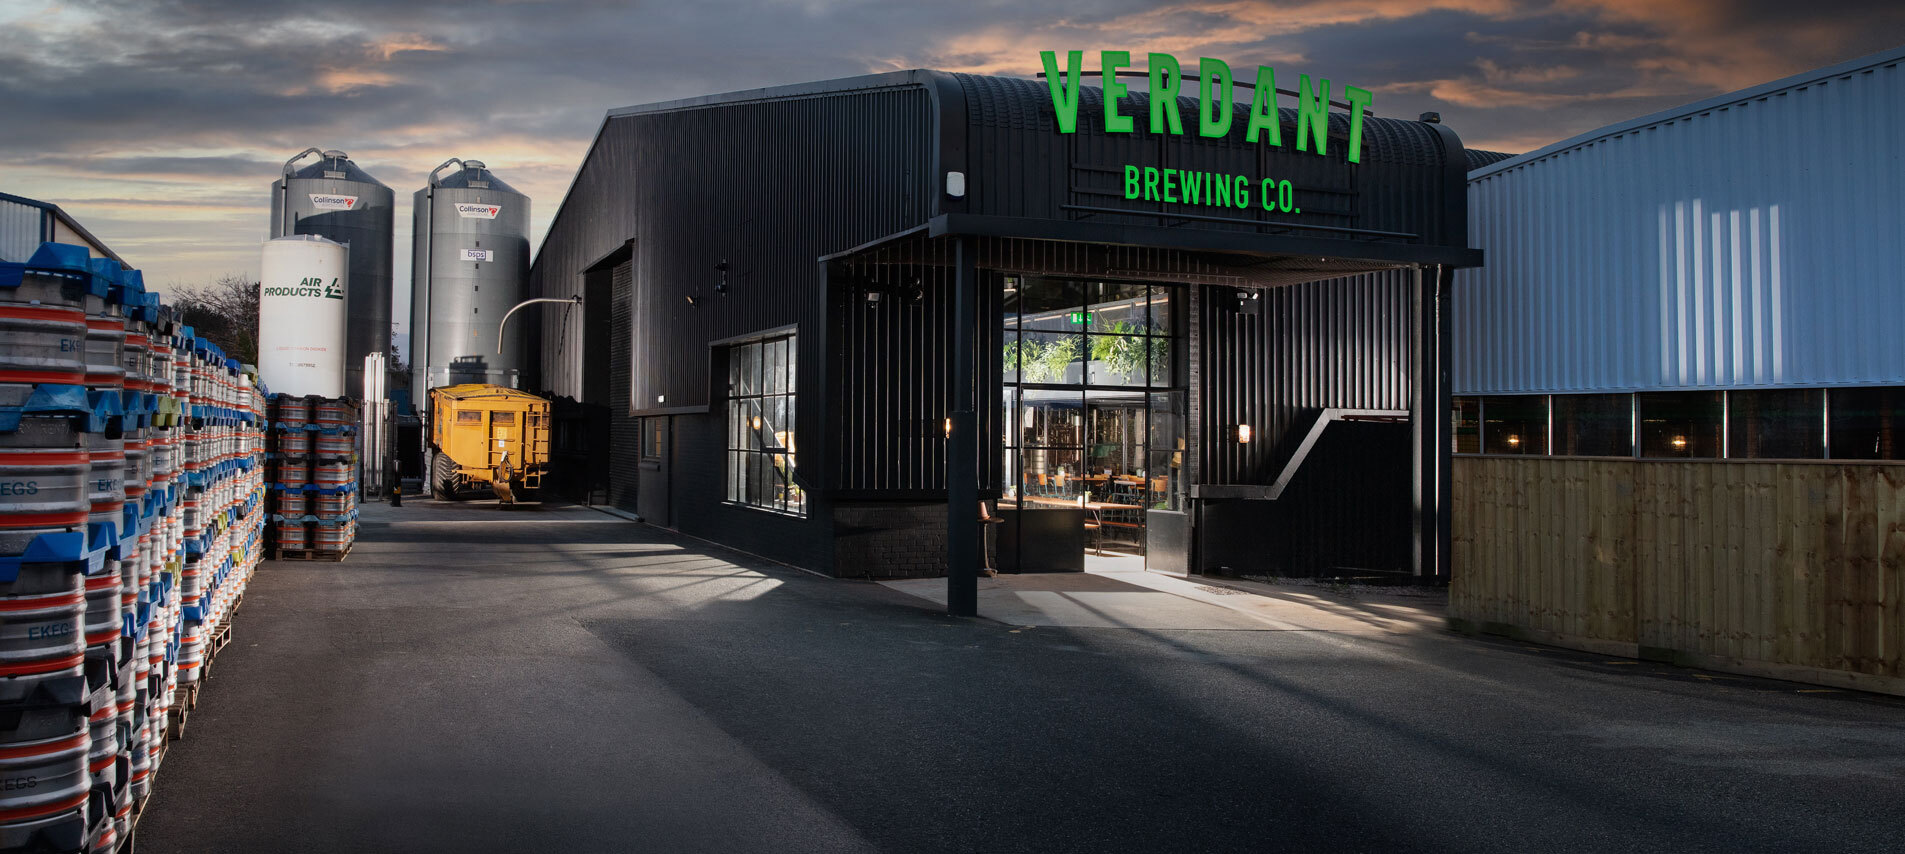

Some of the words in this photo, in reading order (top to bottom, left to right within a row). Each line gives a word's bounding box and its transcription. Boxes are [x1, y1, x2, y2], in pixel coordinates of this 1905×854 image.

[1040, 50, 1373, 164] VERDANT
[1125, 165, 1249, 209] BREWING
[1261, 178, 1301, 214] CO.
[313, 196, 345, 204] Collinson
[459, 205, 489, 213] Collinson
[300, 277, 322, 287] AIR
[264, 287, 321, 297] PRODUCTS
